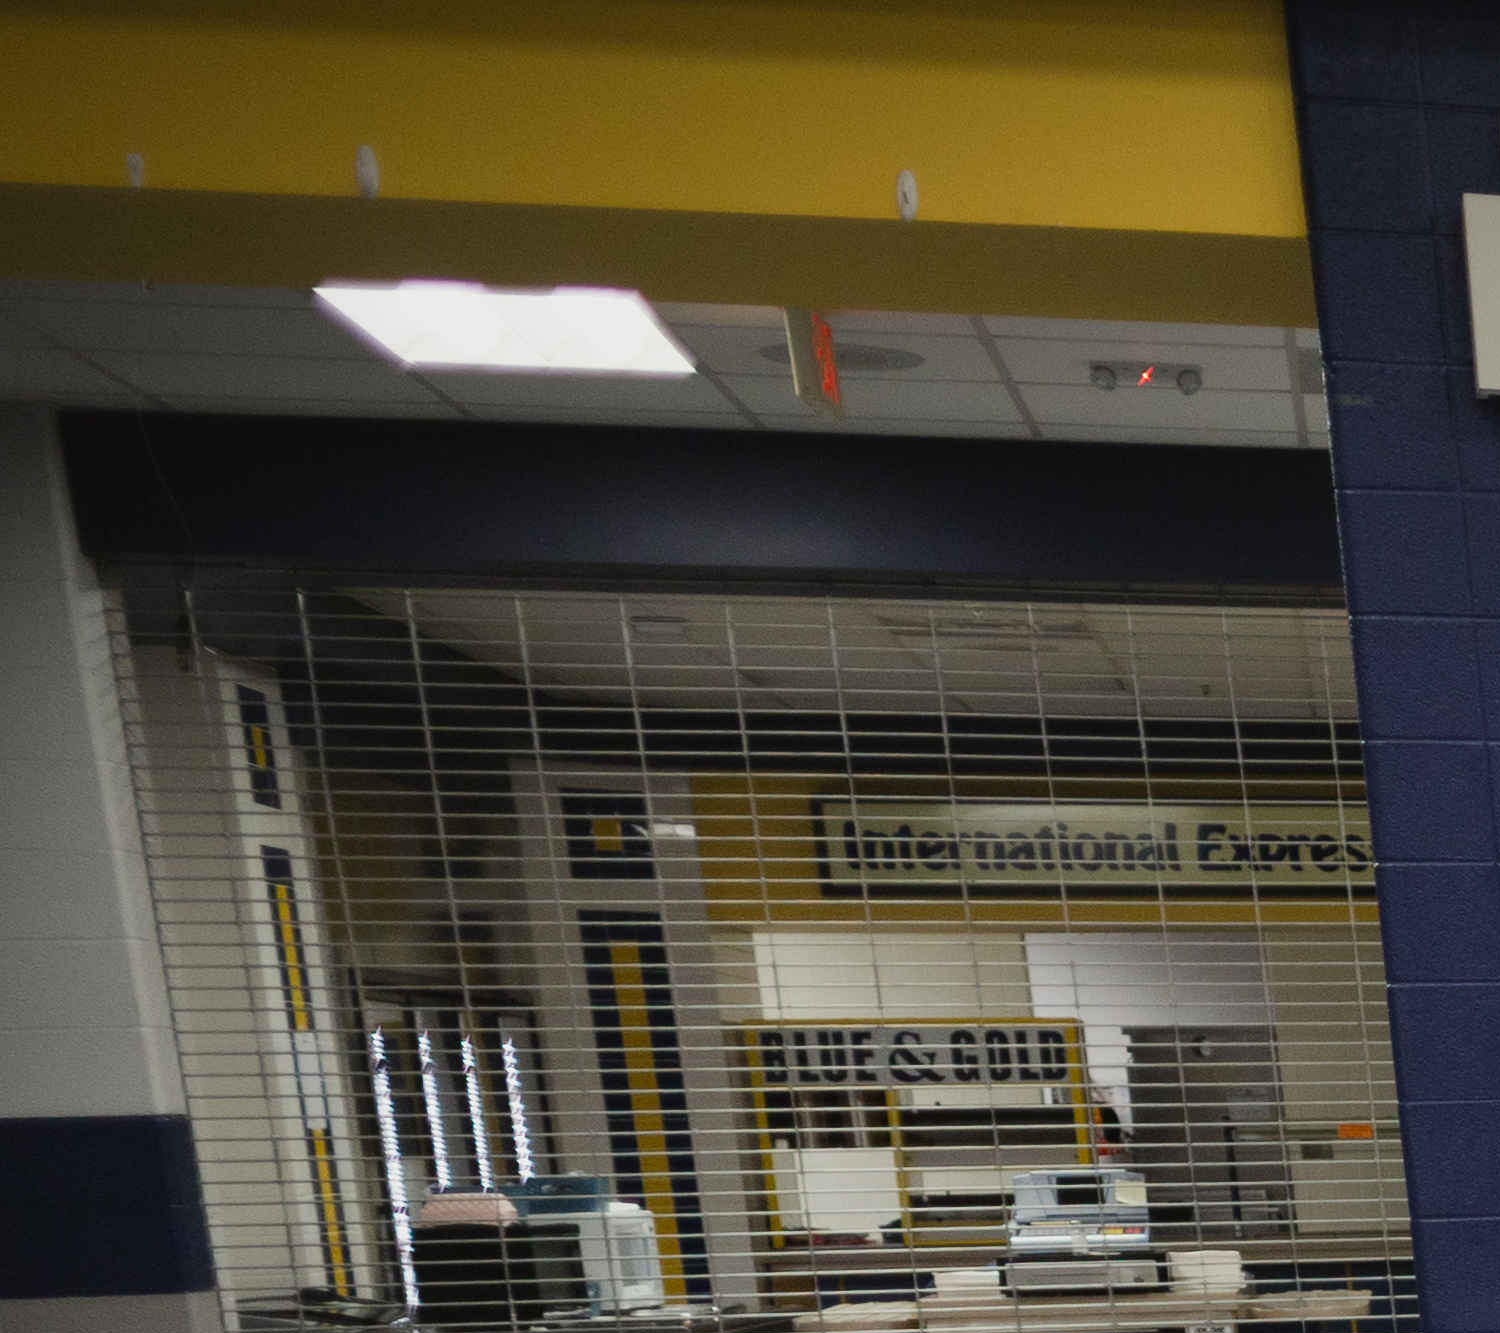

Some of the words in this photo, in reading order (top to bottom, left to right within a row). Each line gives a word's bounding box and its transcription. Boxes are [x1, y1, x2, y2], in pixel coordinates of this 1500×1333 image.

[842, 820, 1182, 873] International
[1197, 823, 1373, 873] Expres
[758, 1029, 878, 1085] BLUE
[888, 1031, 946, 1083] &
[951, 1028, 1069, 1083] GOLD
